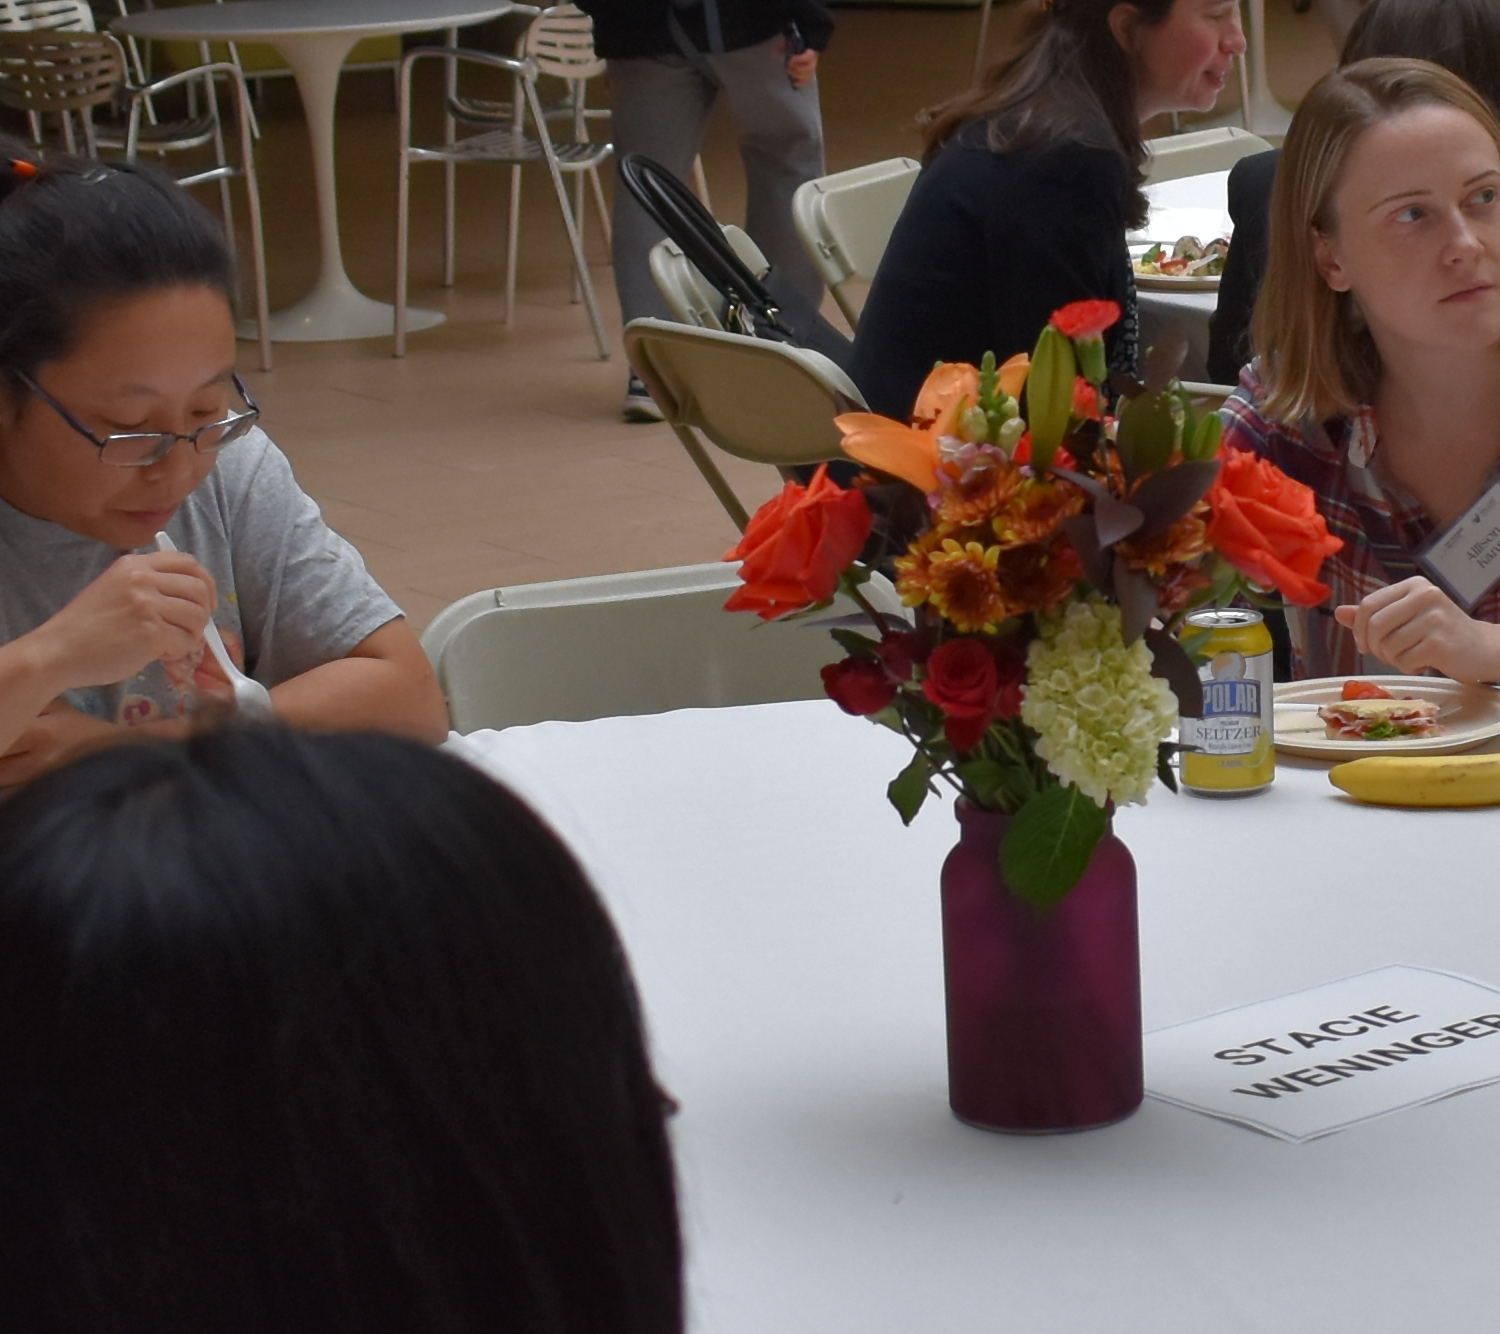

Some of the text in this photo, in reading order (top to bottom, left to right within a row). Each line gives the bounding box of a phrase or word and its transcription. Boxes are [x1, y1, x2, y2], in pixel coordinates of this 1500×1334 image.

[1203, 682, 1258, 714] POLAR
[1196, 724, 1261, 740] SELTZER
[1213, 1004, 1420, 1067] STACIE
